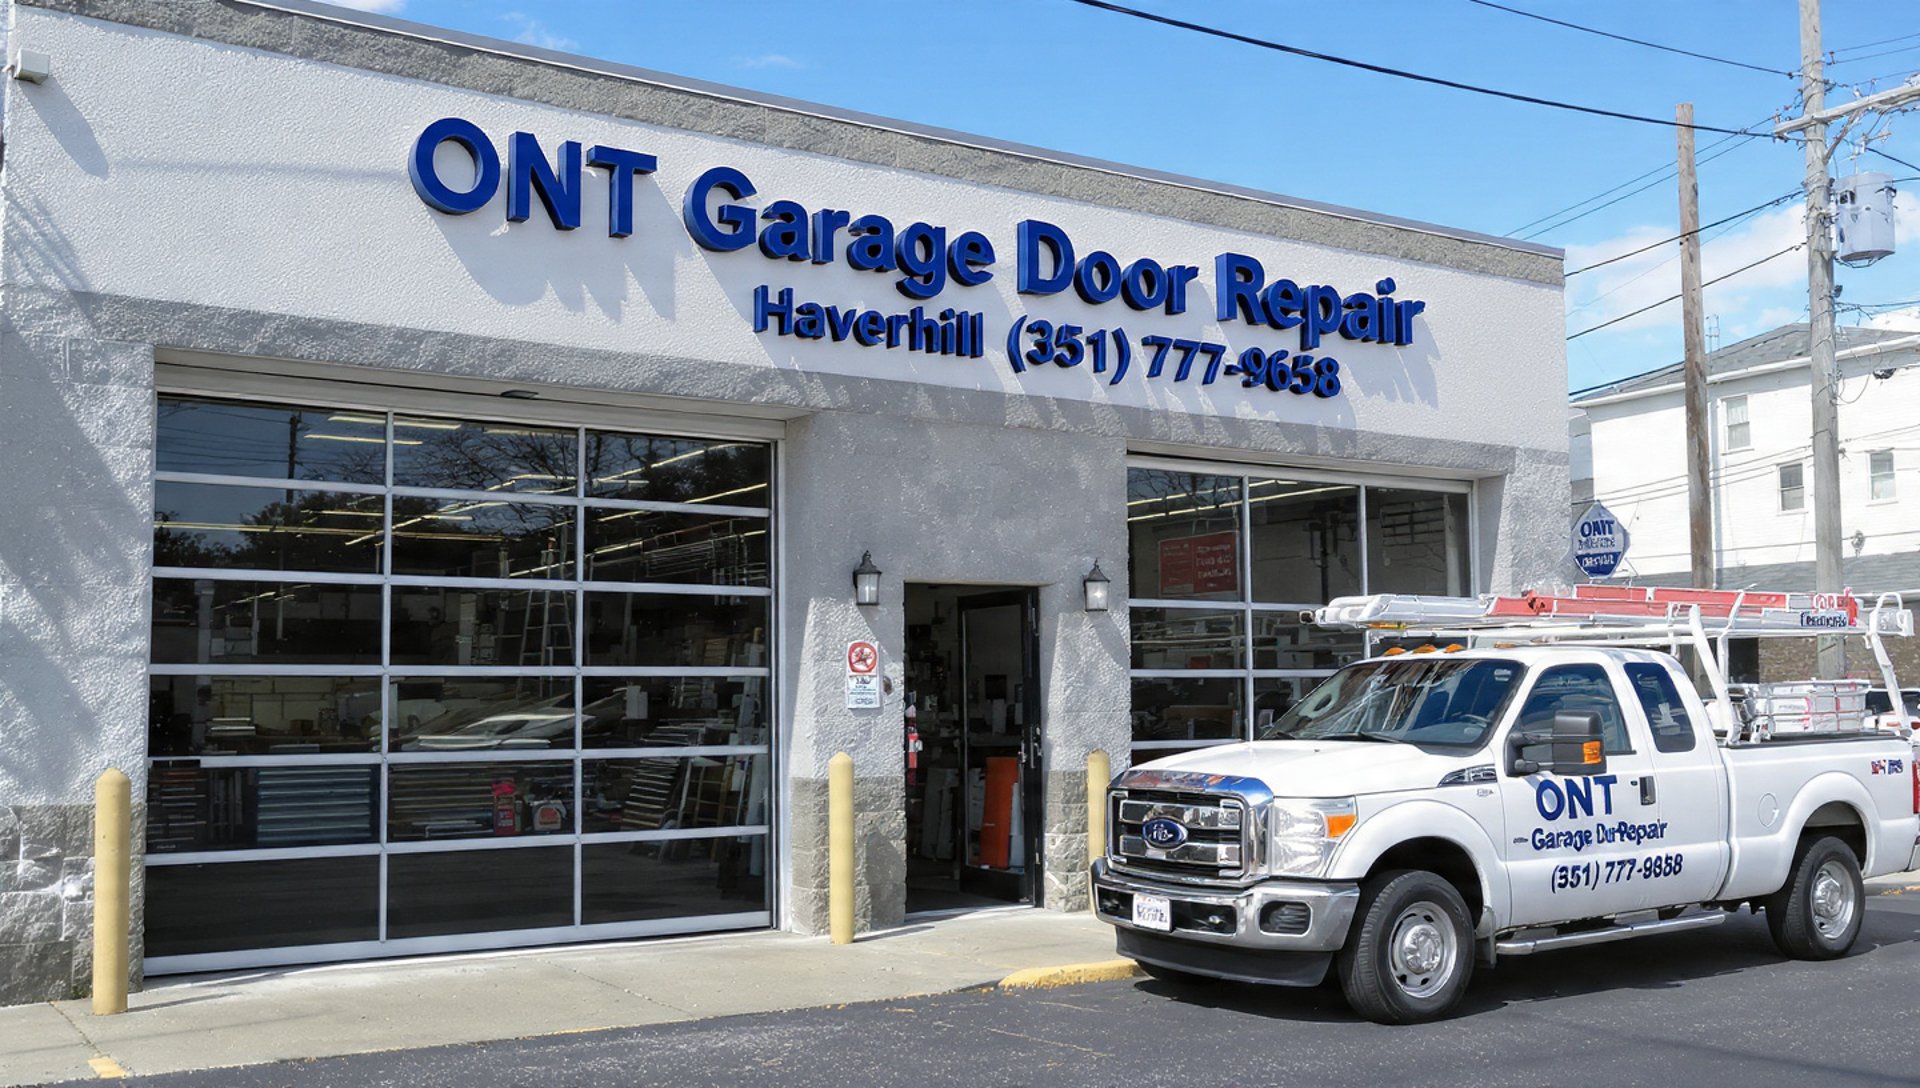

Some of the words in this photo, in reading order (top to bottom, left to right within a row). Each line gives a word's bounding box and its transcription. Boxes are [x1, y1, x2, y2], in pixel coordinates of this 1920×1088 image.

[408, 118, 657, 238] ONT
[683, 166, 994, 299] Garage
[1017, 219, 1199, 316] Door
[1215, 252, 1425, 350] Repair
[753, 284, 983, 358] Haverhill
[1006, 314, 1131, 385] (351)
[1142, 335, 1341, 398] 777-9658
[1536, 775, 1617, 821] ONT
[1531, 827, 1593, 852] Garage
[1551, 860, 1600, 894] (351)
